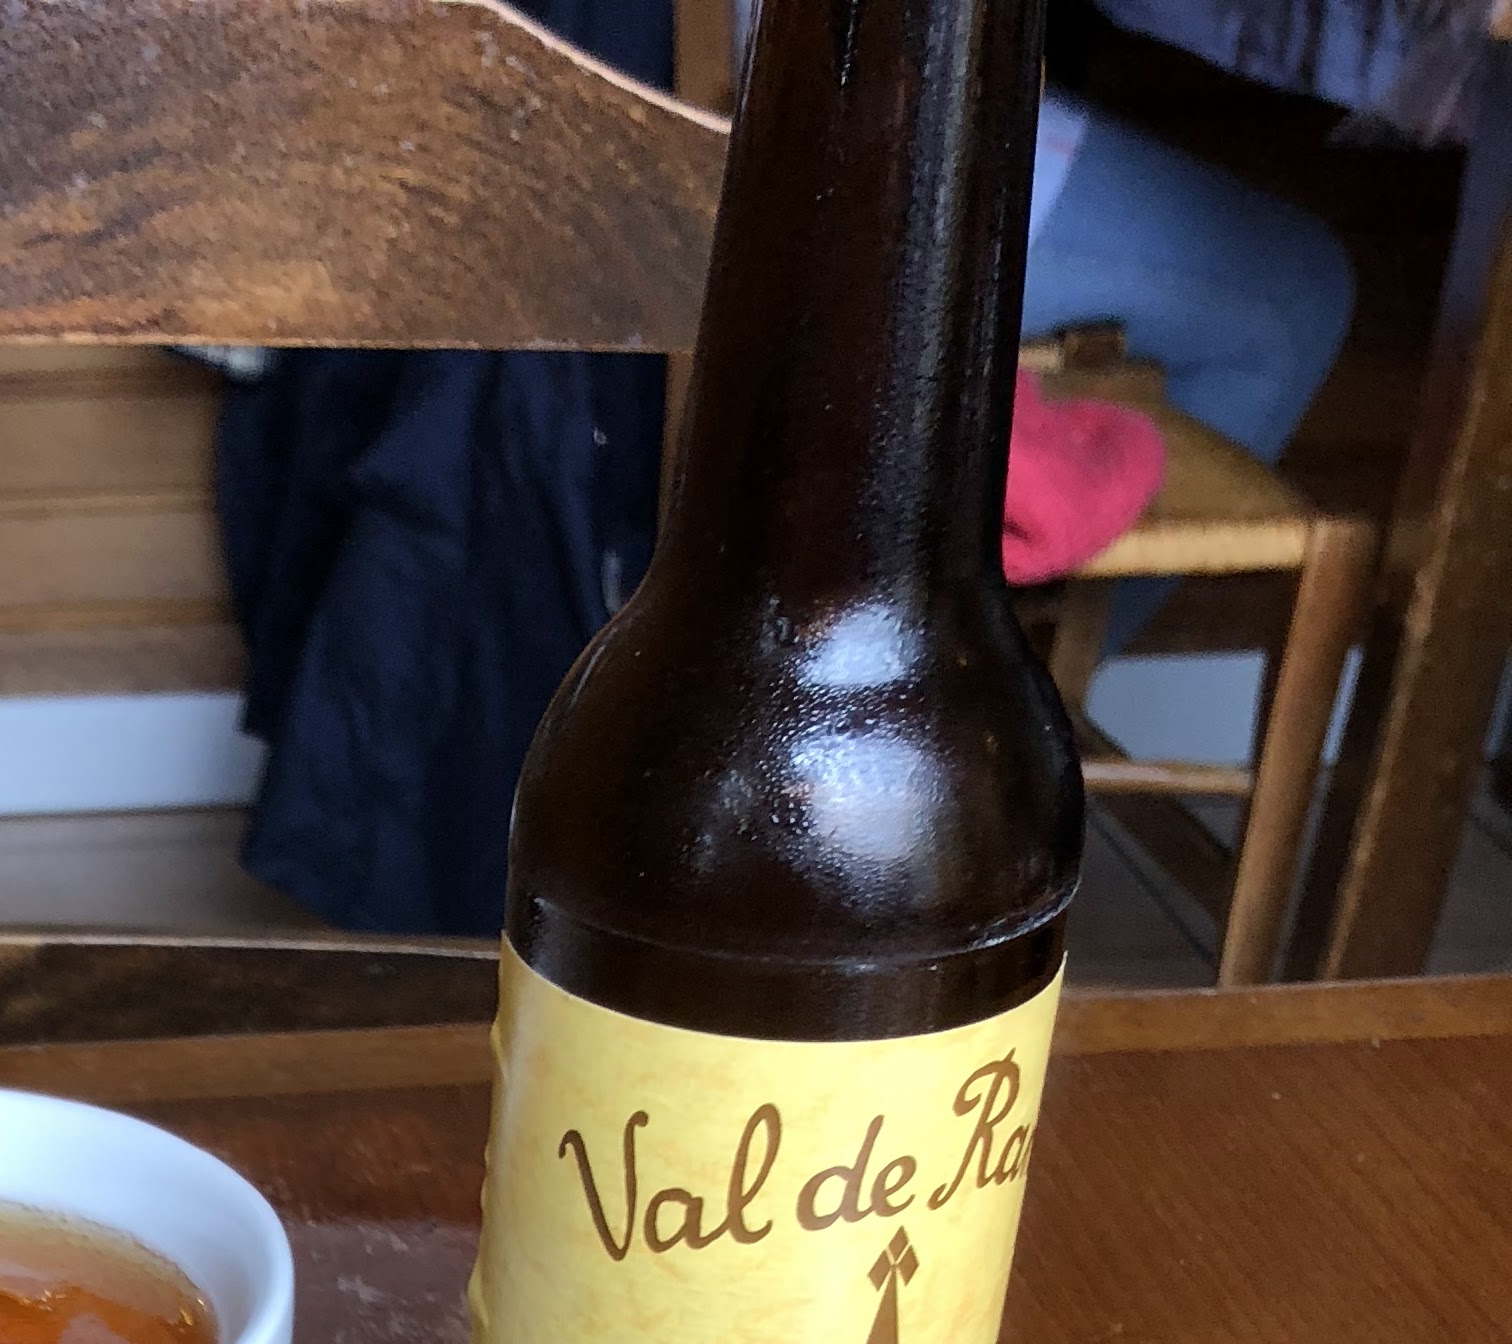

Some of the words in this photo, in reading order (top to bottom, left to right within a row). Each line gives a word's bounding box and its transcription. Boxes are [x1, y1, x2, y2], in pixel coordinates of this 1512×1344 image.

[559, 1102, 782, 1261] Val
[795, 1114, 917, 1231] de
[926, 1047, 1034, 1211] Ra
